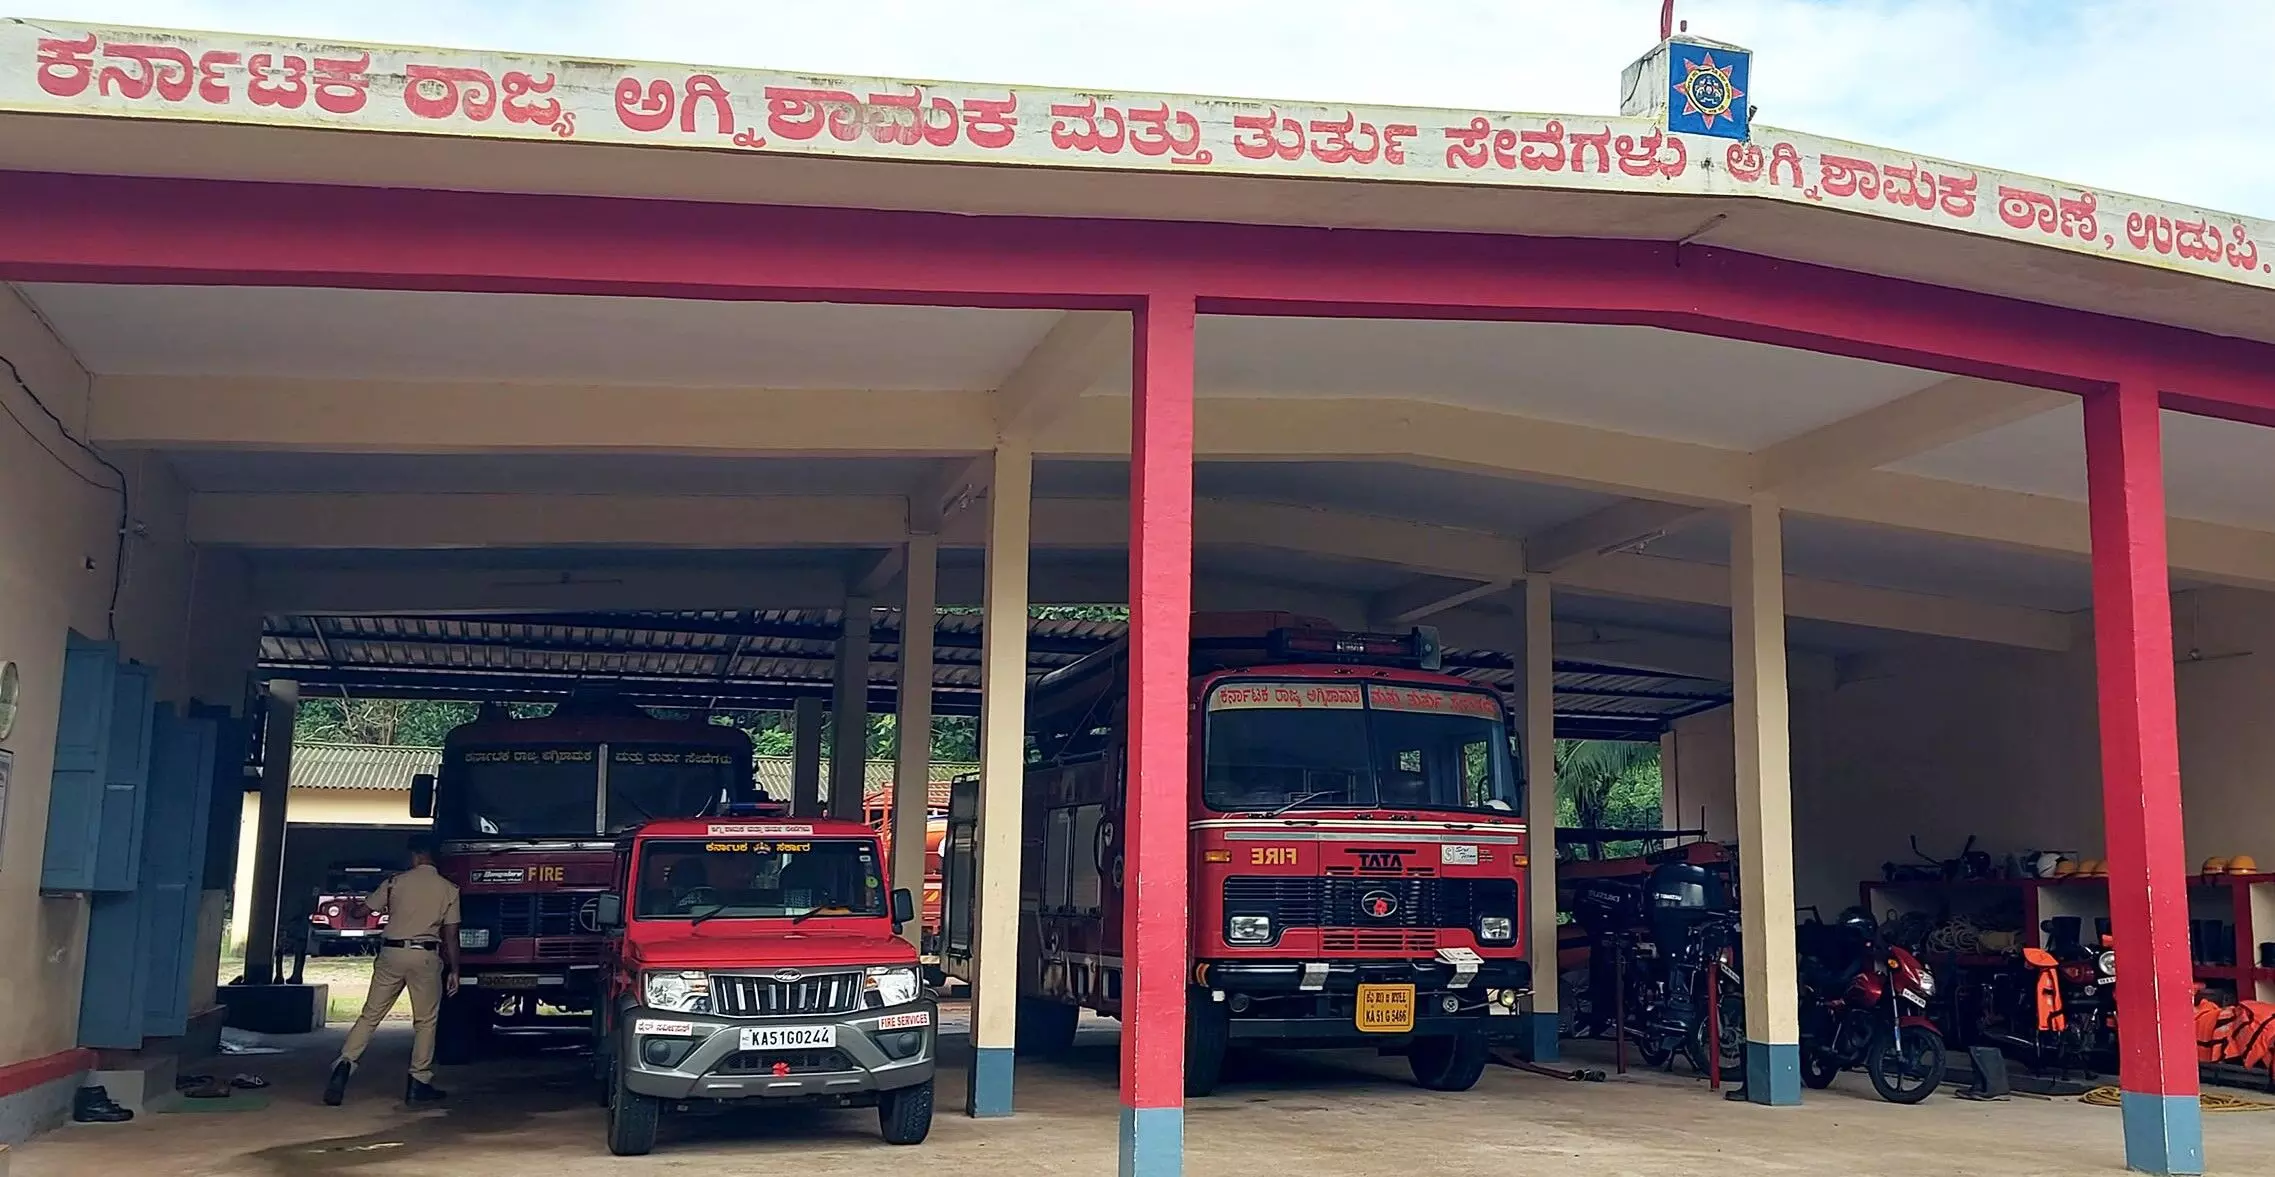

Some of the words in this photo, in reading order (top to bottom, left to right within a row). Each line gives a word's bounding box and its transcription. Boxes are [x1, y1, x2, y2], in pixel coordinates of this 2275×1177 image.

[37, 31, 370, 113] ಕರ್ನಾಟಕ
[405, 64, 577, 138] ರಾಜ್ಯ
[1050, 97, 1212, 165] ಮತ್ತು
[1233, 107, 1417, 165] ತುರ್ತು
[1445, 116, 1686, 178] ಸೇವೆಗಳು
[1726, 141, 1978, 218] ಅಗ್ನಿಶಾಮಕ
[1998, 185, 2114, 249] ಠಾಣೆ,
[2126, 210, 2271, 273] ಉಡುಪಿ.
[1220, 686, 1268, 704] ಕರ್ನಾಟಕ
[706, 842, 748, 852] ಕರ್ನಾಟಕ
[1359, 853, 1403, 868] TATA
[528, 867, 564, 881] FIRE
[881, 1016, 896, 1028] FIRE
[897, 1013, 928, 1026] SERVICES
[1366, 1010, 1375, 1022] KA
[1376, 1010, 1384, 1022] 51
[752, 1029, 829, 1046] KA51G0244
